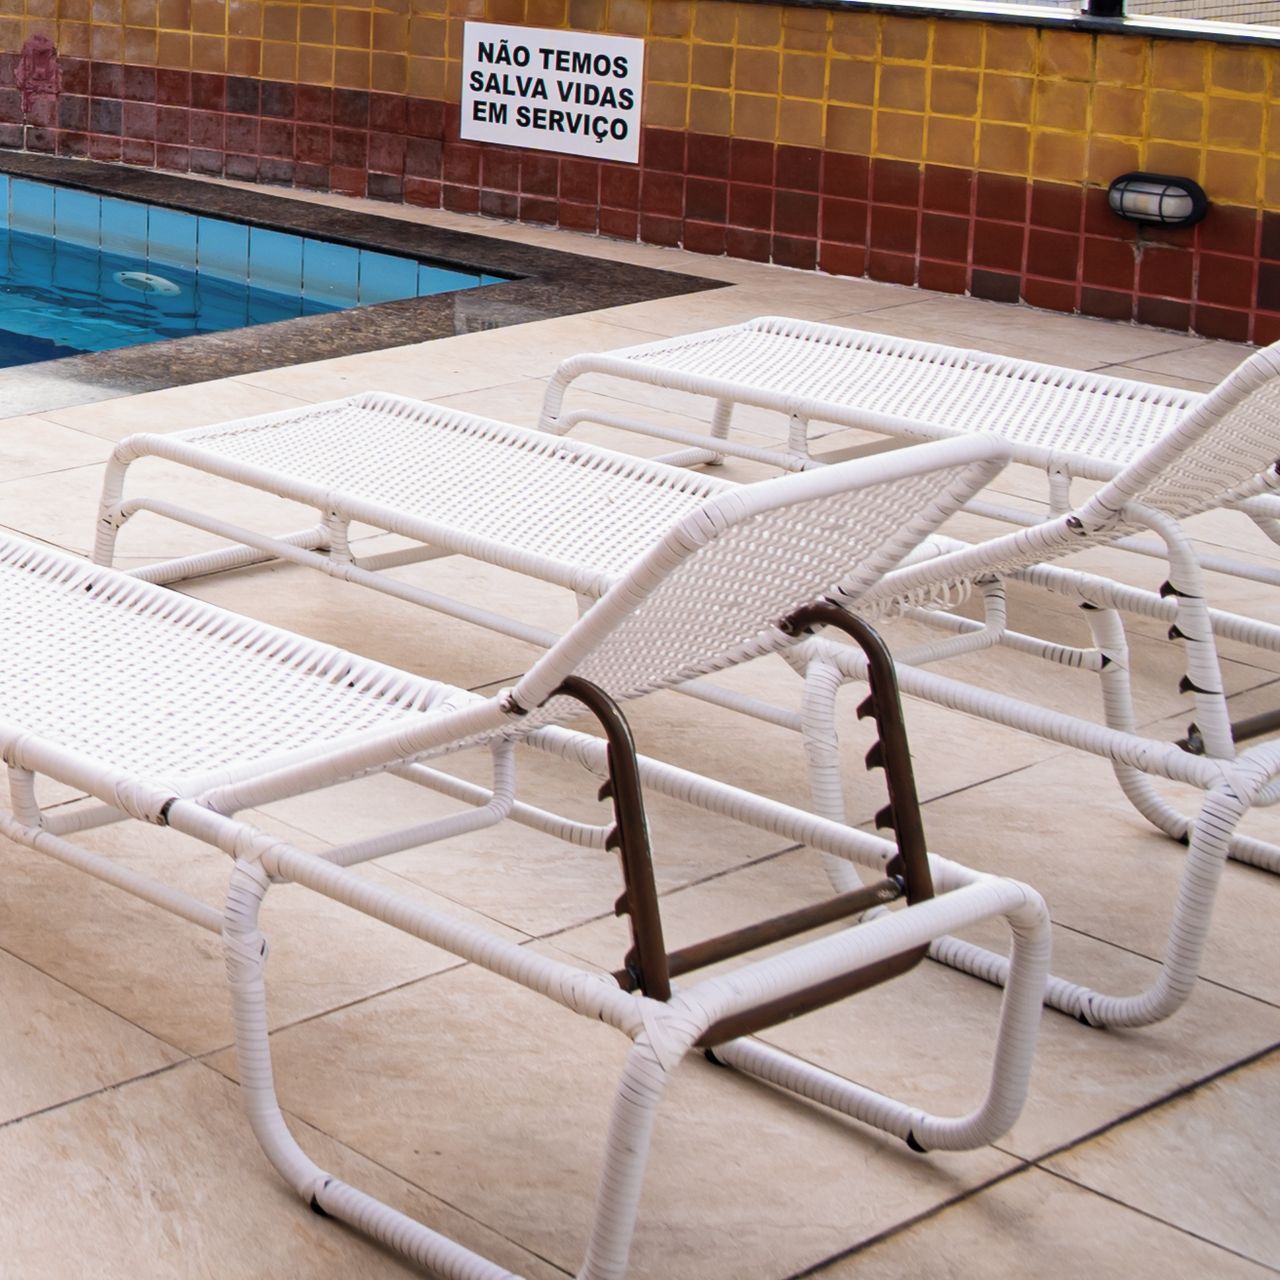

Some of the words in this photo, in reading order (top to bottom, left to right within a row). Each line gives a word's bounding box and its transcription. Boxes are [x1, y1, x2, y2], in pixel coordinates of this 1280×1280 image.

[477, 39, 530, 67] NÃO
[539, 48, 628, 78] TEMOS
[469, 71, 548, 100] SALVA
[557, 80, 634, 110] VIDAS
[473, 100, 507, 124] EM
[516, 106, 628, 143] SERVIÇO
